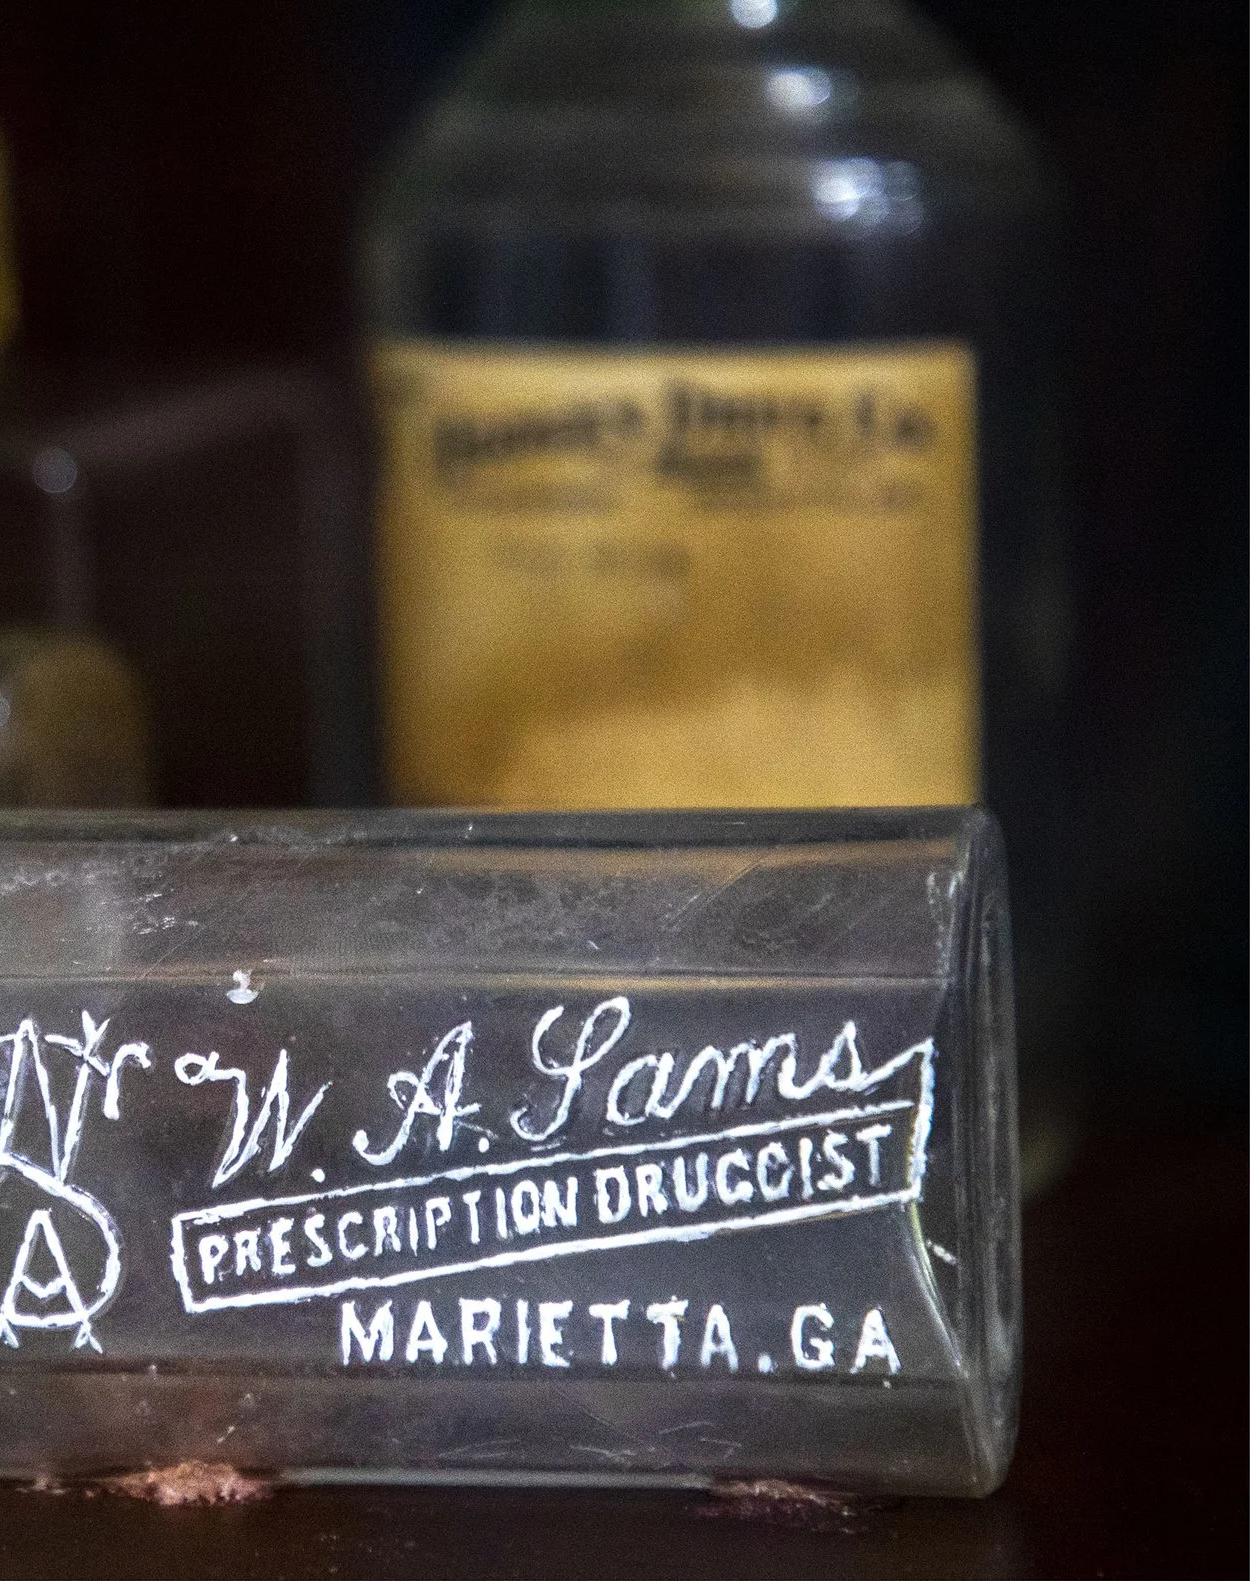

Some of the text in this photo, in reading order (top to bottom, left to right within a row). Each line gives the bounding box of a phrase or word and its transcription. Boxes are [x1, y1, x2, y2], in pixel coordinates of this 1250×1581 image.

[174, 996, 936, 1188] W. A. Sams
[198, 1168, 579, 1285] PRESCRIPTION
